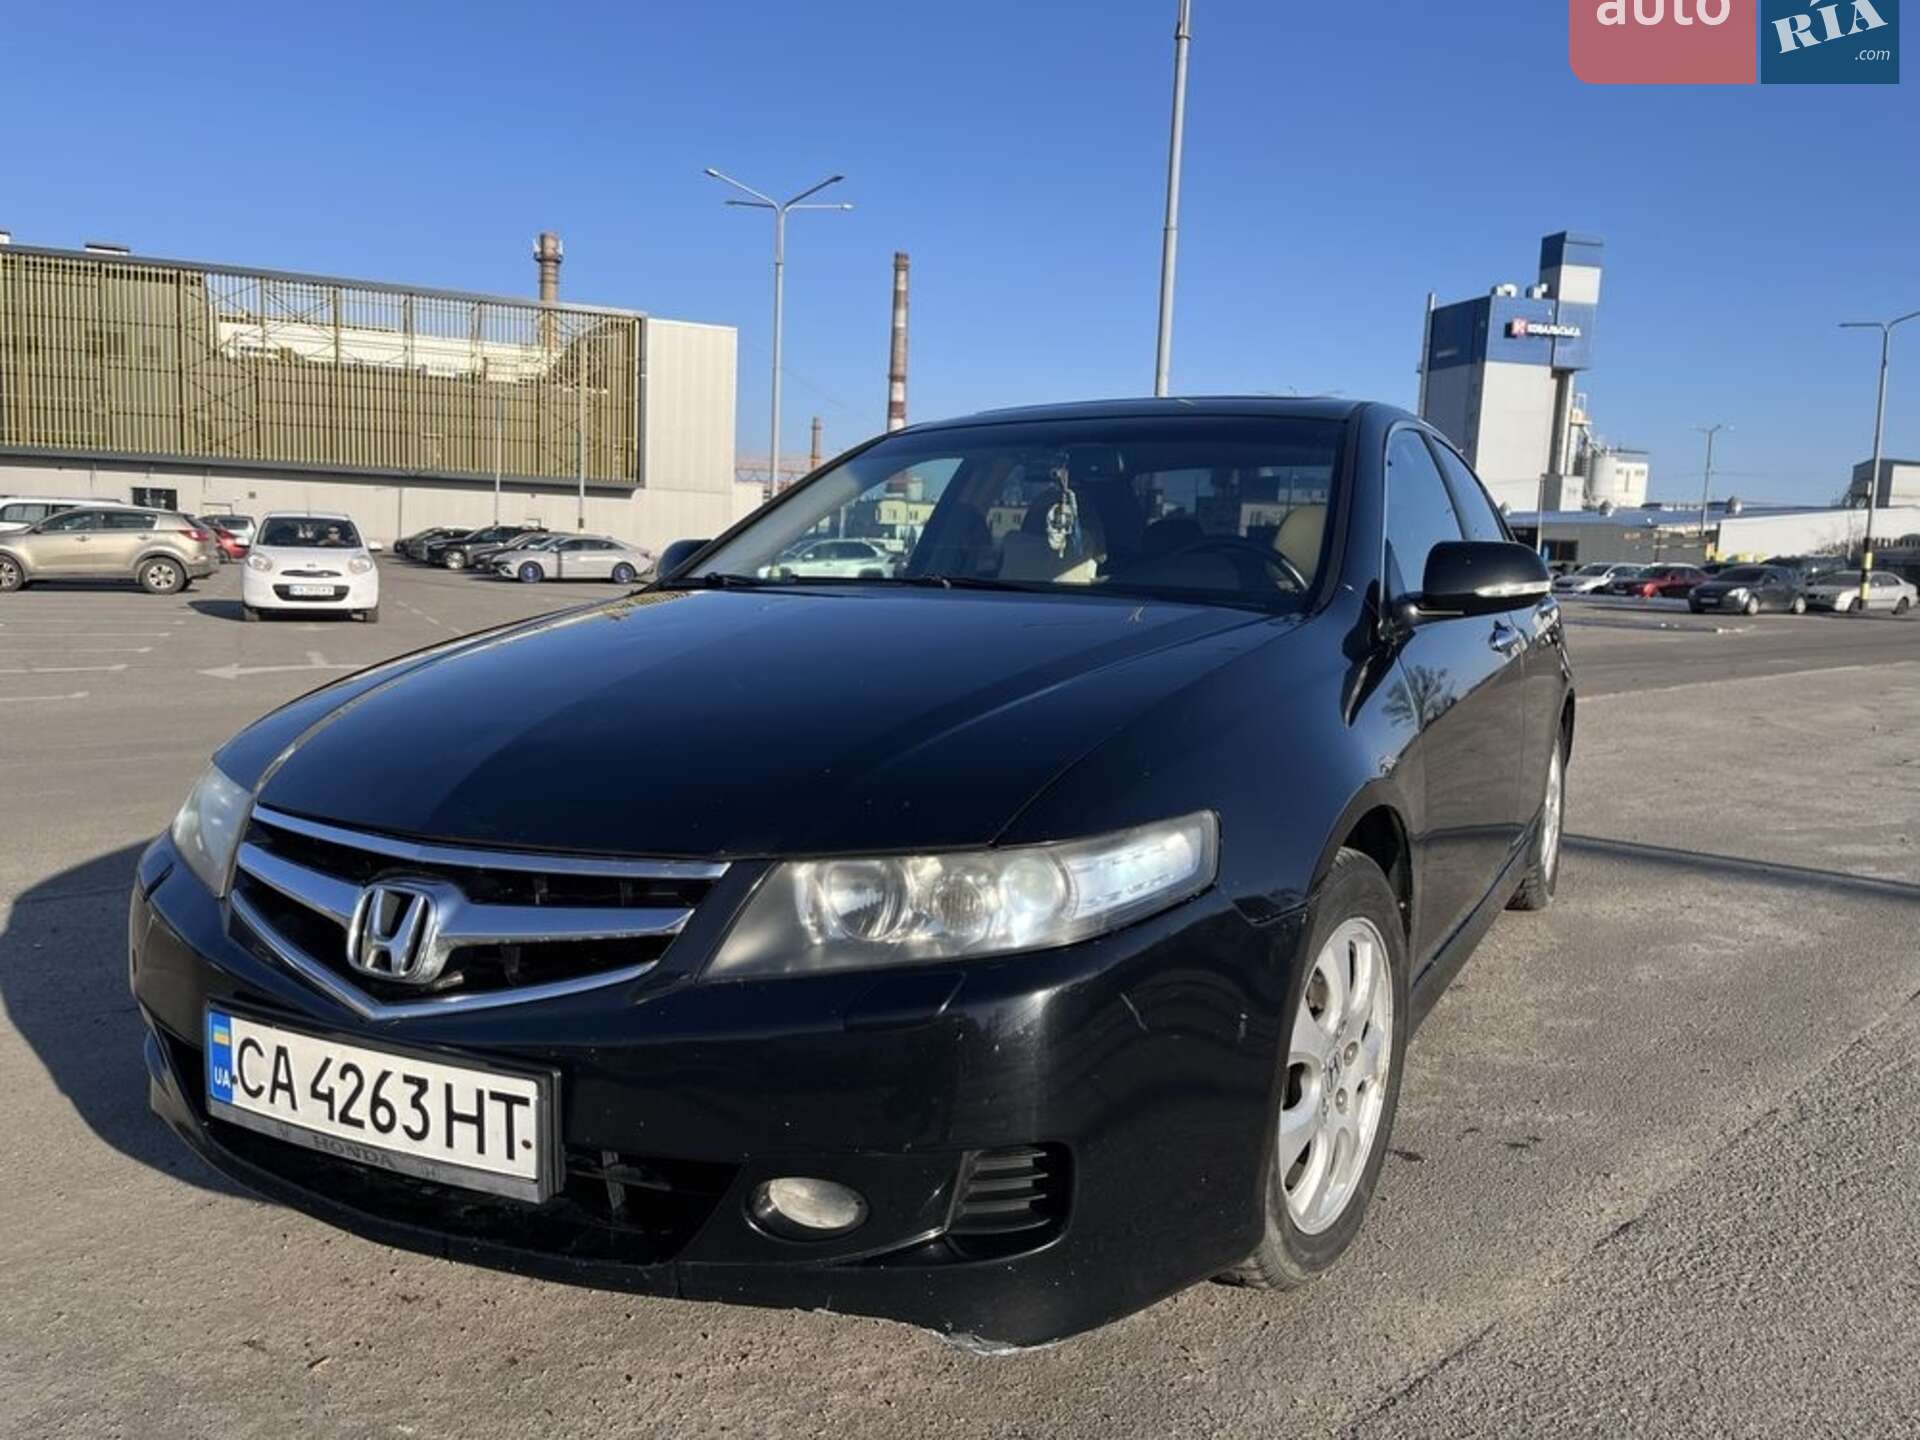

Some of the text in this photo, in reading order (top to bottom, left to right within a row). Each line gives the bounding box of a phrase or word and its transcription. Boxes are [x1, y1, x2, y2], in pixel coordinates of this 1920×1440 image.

[214, 1065, 231, 1088] UA
[237, 1037, 531, 1160] CA 4263 HT
[311, 1134, 398, 1169] HONDA
